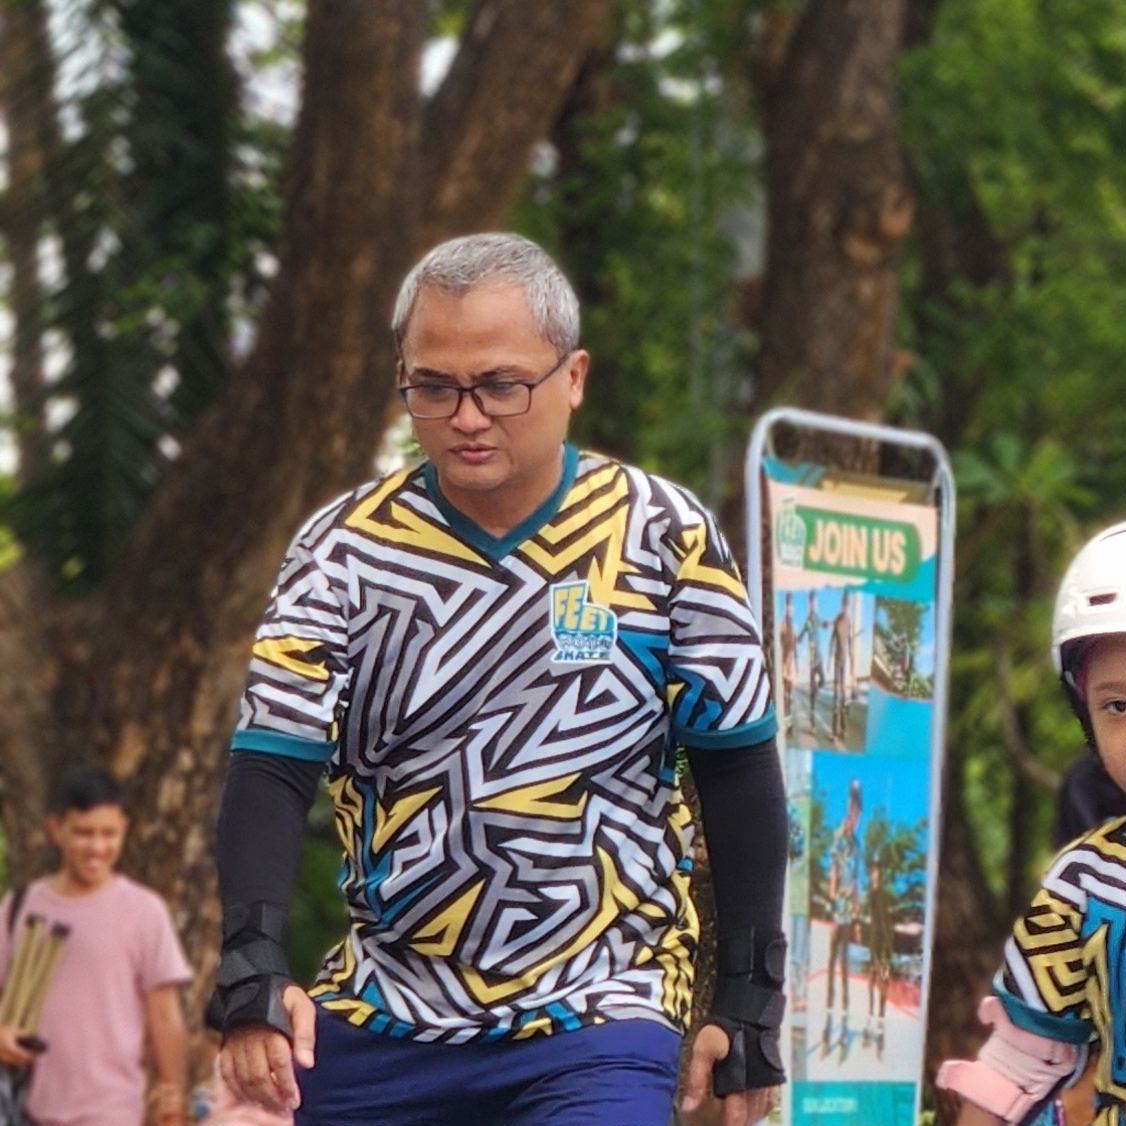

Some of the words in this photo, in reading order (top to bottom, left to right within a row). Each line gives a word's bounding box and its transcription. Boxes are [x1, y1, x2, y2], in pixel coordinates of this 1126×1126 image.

[808, 519, 867, 570] JOIN
[872, 529, 906, 575] US
[554, 586, 608, 631] FEET
